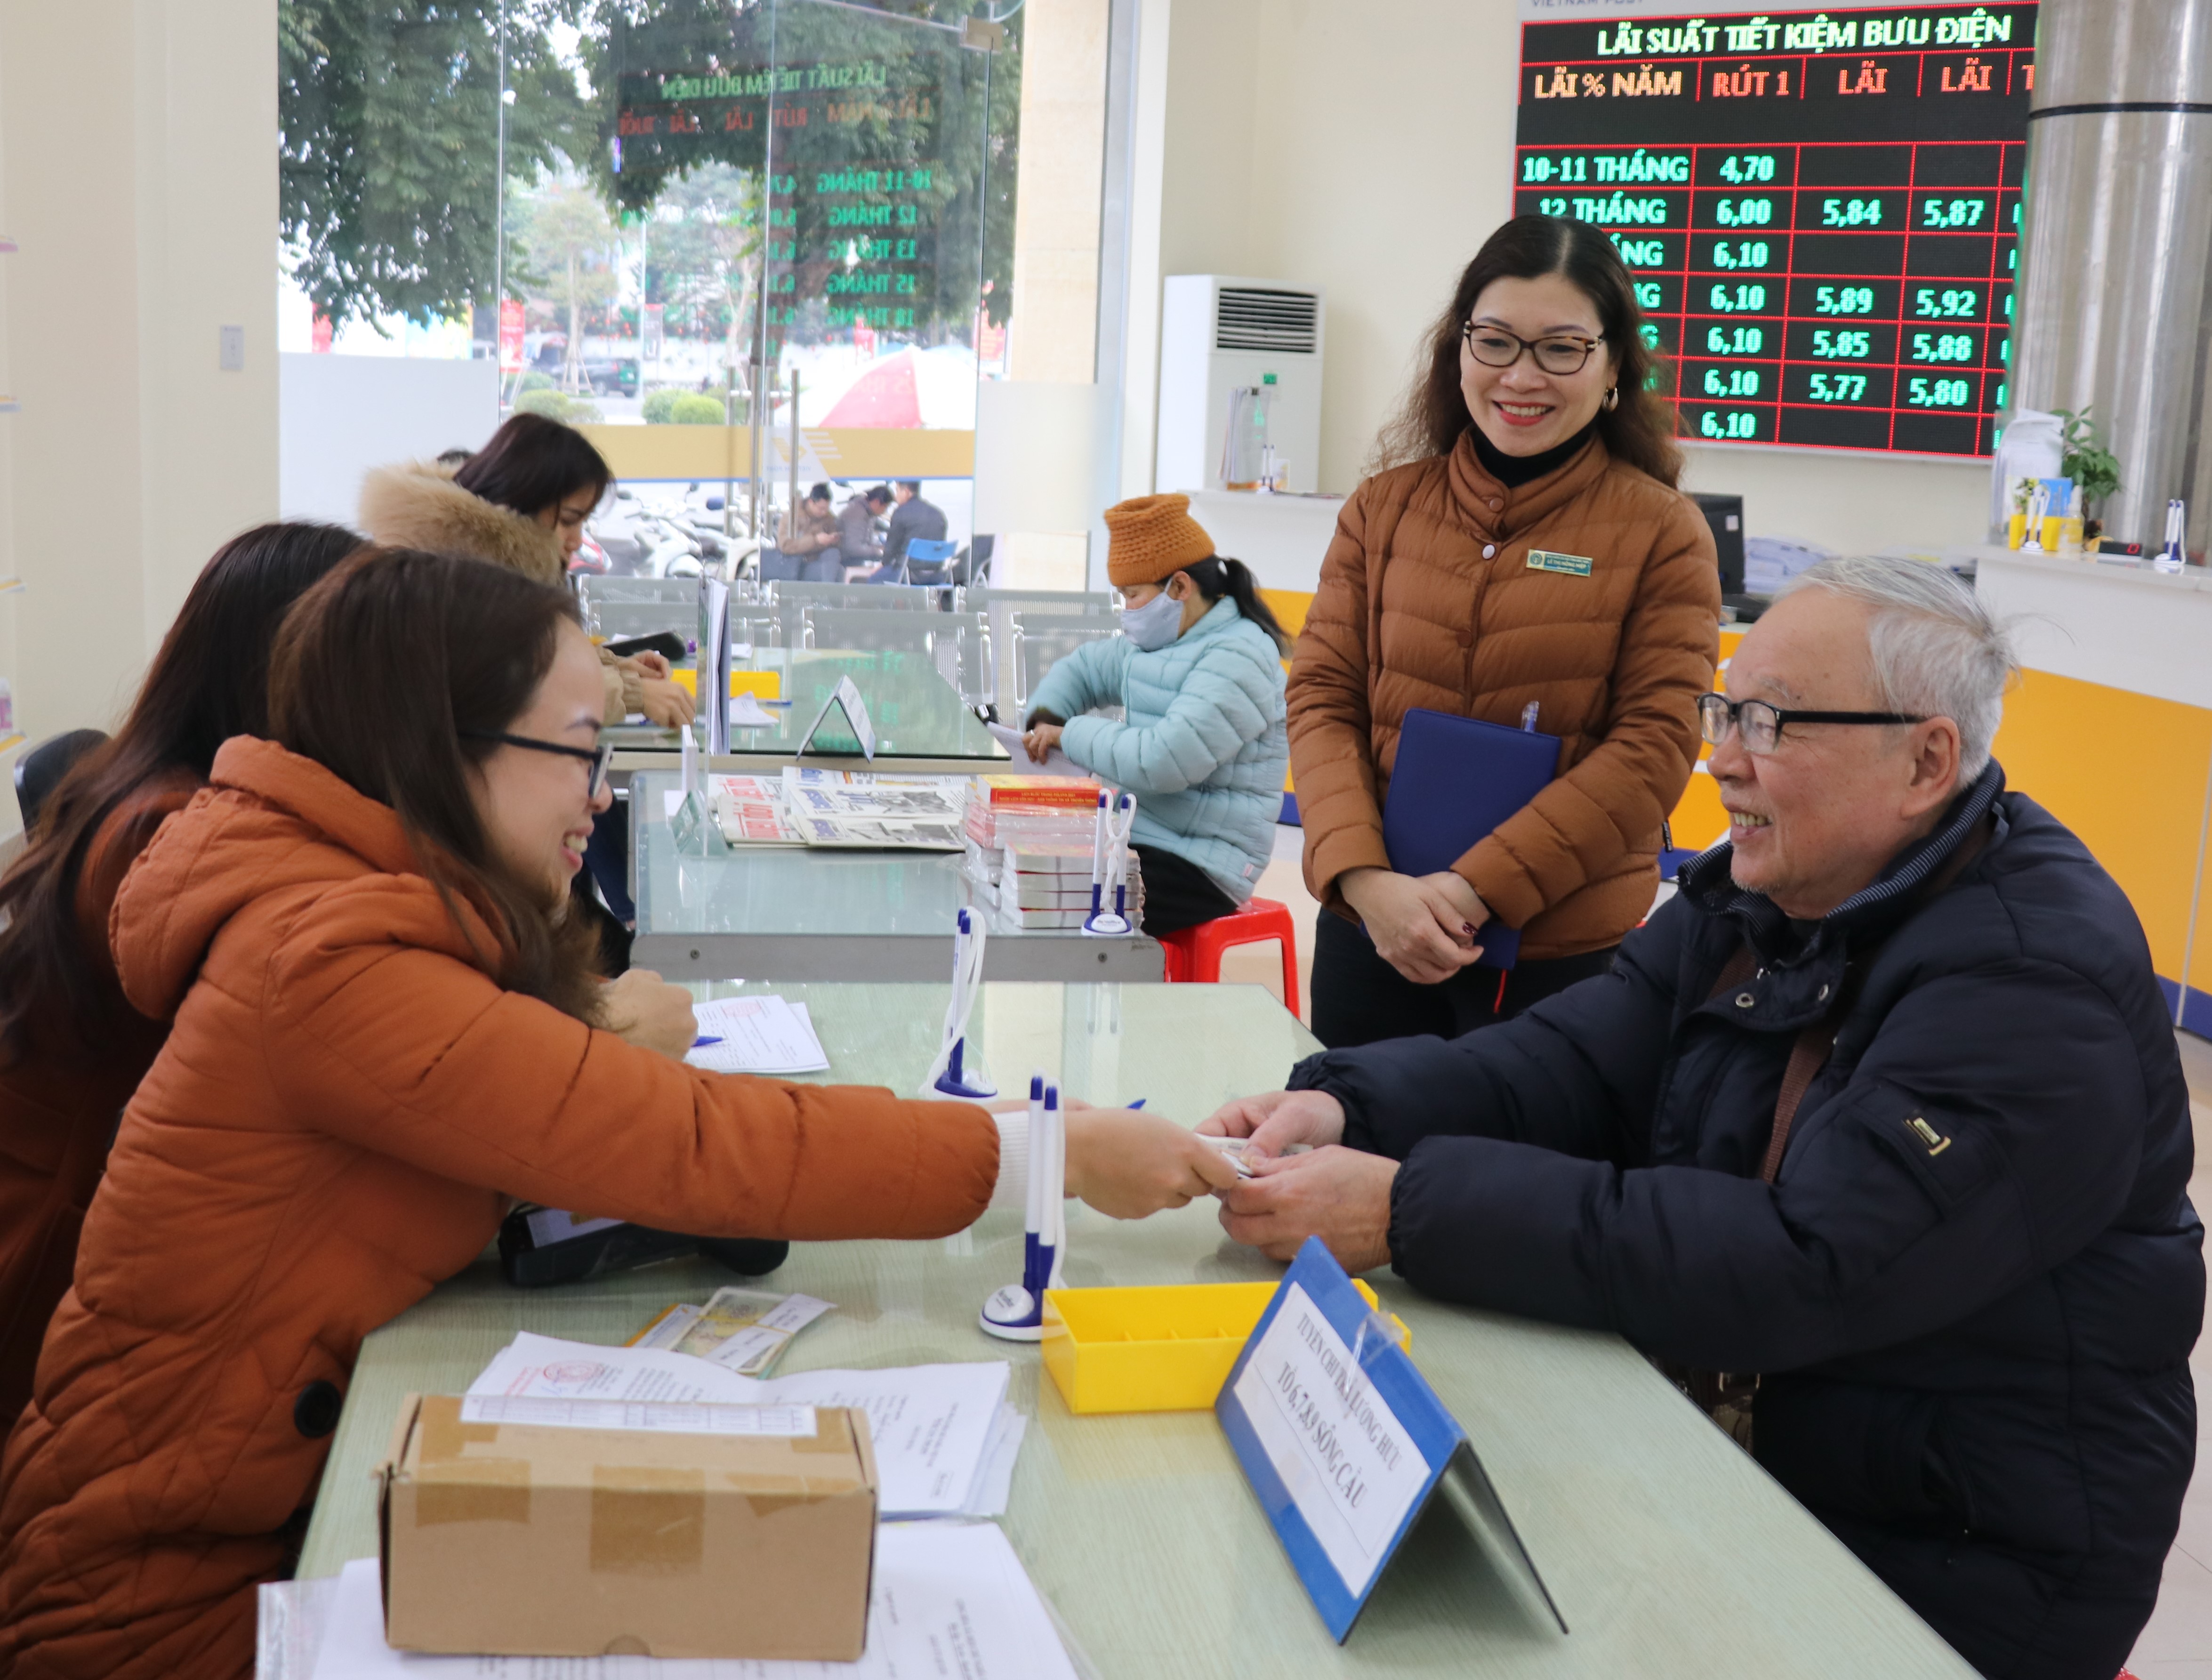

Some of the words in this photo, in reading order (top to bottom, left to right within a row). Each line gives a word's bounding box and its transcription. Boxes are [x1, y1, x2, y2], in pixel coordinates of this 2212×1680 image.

[1597, 21, 1643, 56] LÃI
[1647, 18, 1720, 53] SUẤT
[1724, 17, 1780, 51] TIẾT
[1784, 14, 1858, 54] KIỆM
[1863, 16, 1930, 46] BƯU
[1935, 7, 2011, 48] ĐIỆN
[1534, 66, 1578, 98] LÃI
[1582, 73, 1606, 97] %
[1612, 65, 1682, 97] NĂM
[1712, 65, 1769, 97] RÚT
[1776, 71, 1789, 96] 1
[1838, 60, 1888, 94] LÃI
[1940, 57, 1993, 92] LÃI
[1523, 157, 1586, 182] 10-11
[1593, 148, 1689, 182] THÁNG
[1719, 155, 1775, 184] 4,70
[1572, 191, 1666, 224] THÁNG
[1716, 199, 1772, 227] 6,00
[1822, 199, 1882, 227] 5,84
[1923, 200, 1985, 228] 5,87
[1713, 242, 1769, 270] 6,10
[1710, 284, 1766, 312] 6,10
[1816, 286, 1874, 315] 5,89
[1916, 289, 1976, 318] 5,92
[1707, 327, 1762, 355] 6,10
[1812, 330, 1870, 358] 5,85
[1912, 333, 1972, 363] 5,88
[1704, 369, 1760, 397] 6,10
[1809, 374, 1867, 402] 5,77
[1909, 378, 1969, 407] 5,80
[1701, 411, 1757, 439] 6,10
[1321, 1347, 1340, 1378] CHI
[1313, 1420, 1344, 1473] SÔNG
